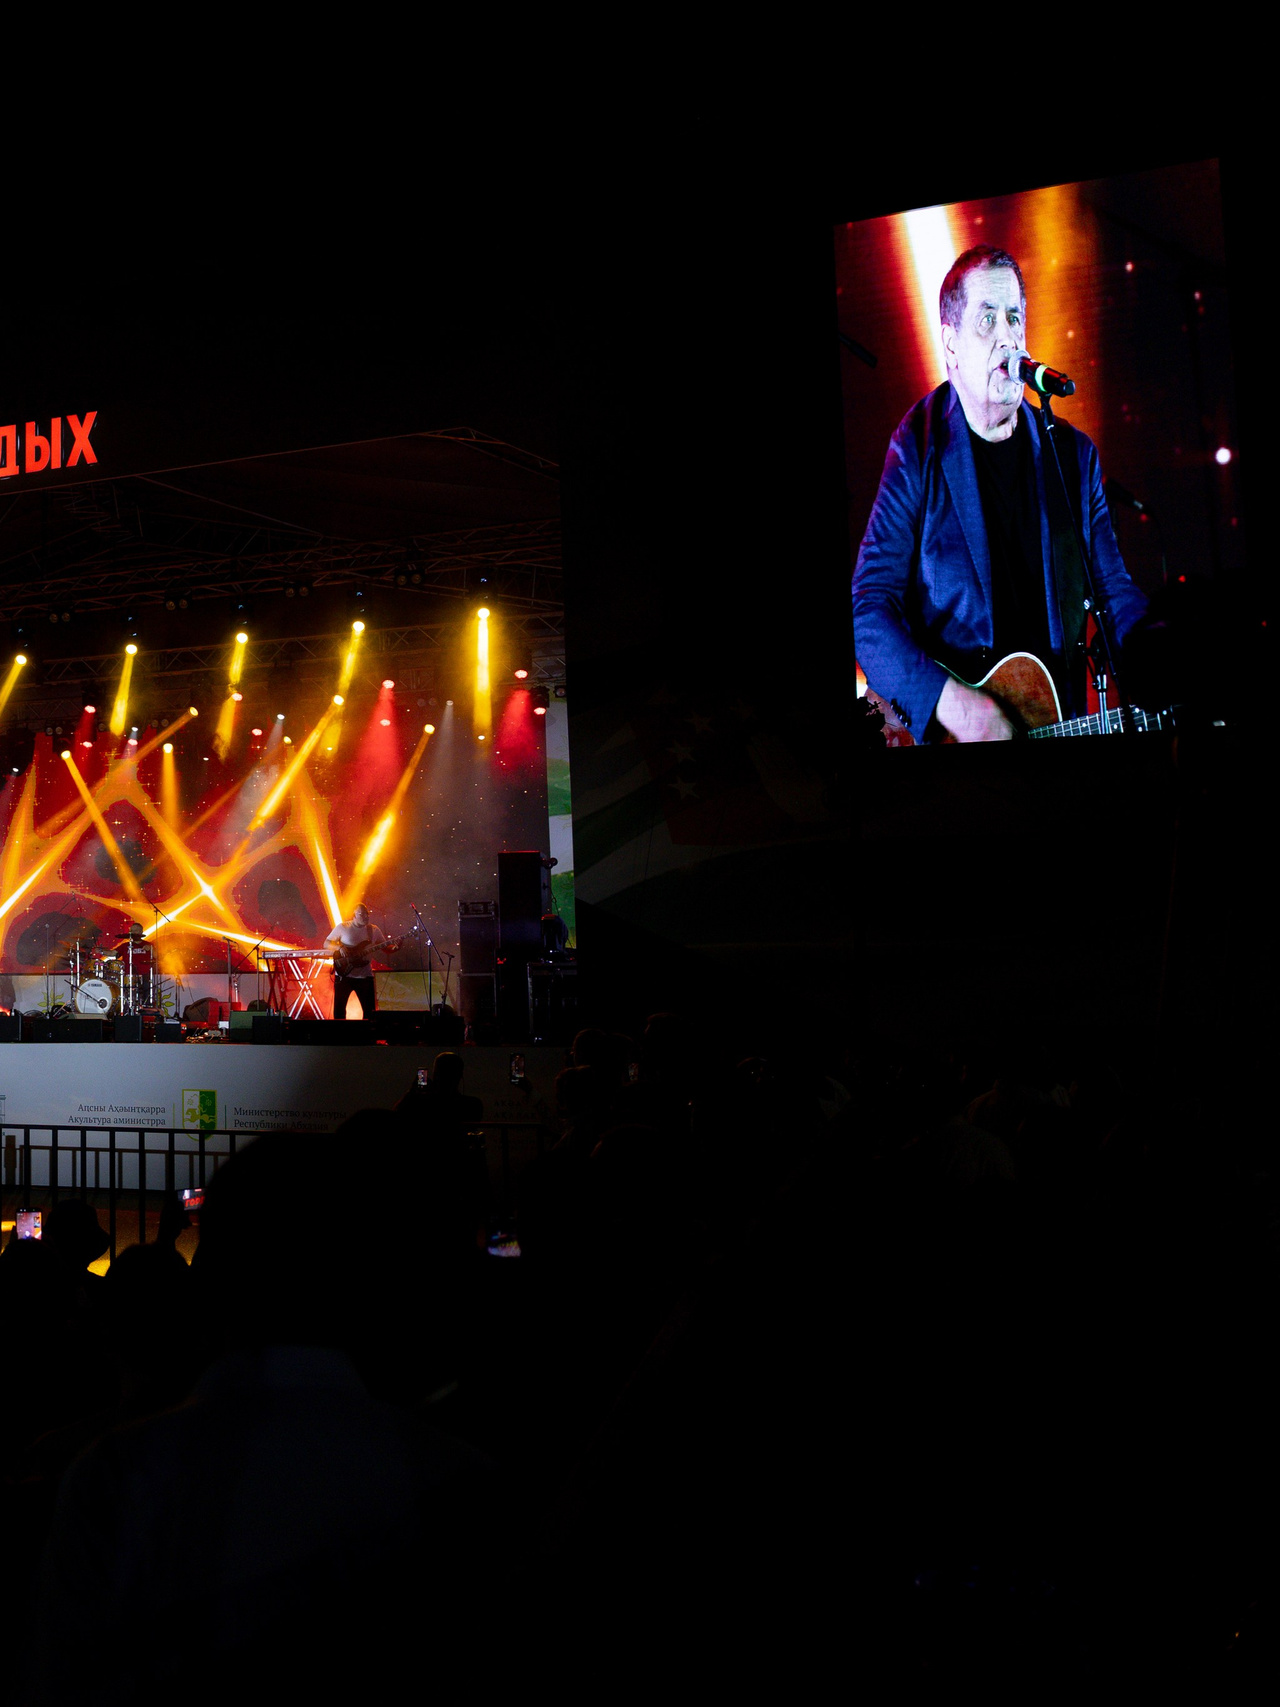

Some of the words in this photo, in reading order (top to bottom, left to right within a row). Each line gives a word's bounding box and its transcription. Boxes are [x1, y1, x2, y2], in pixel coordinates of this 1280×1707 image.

[233, 1106, 300, 1118] Министерство
[302, 1109, 347, 1120] культуры
[67, 1115, 112, 1126] Акультура
[233, 1119, 287, 1130] Республики
